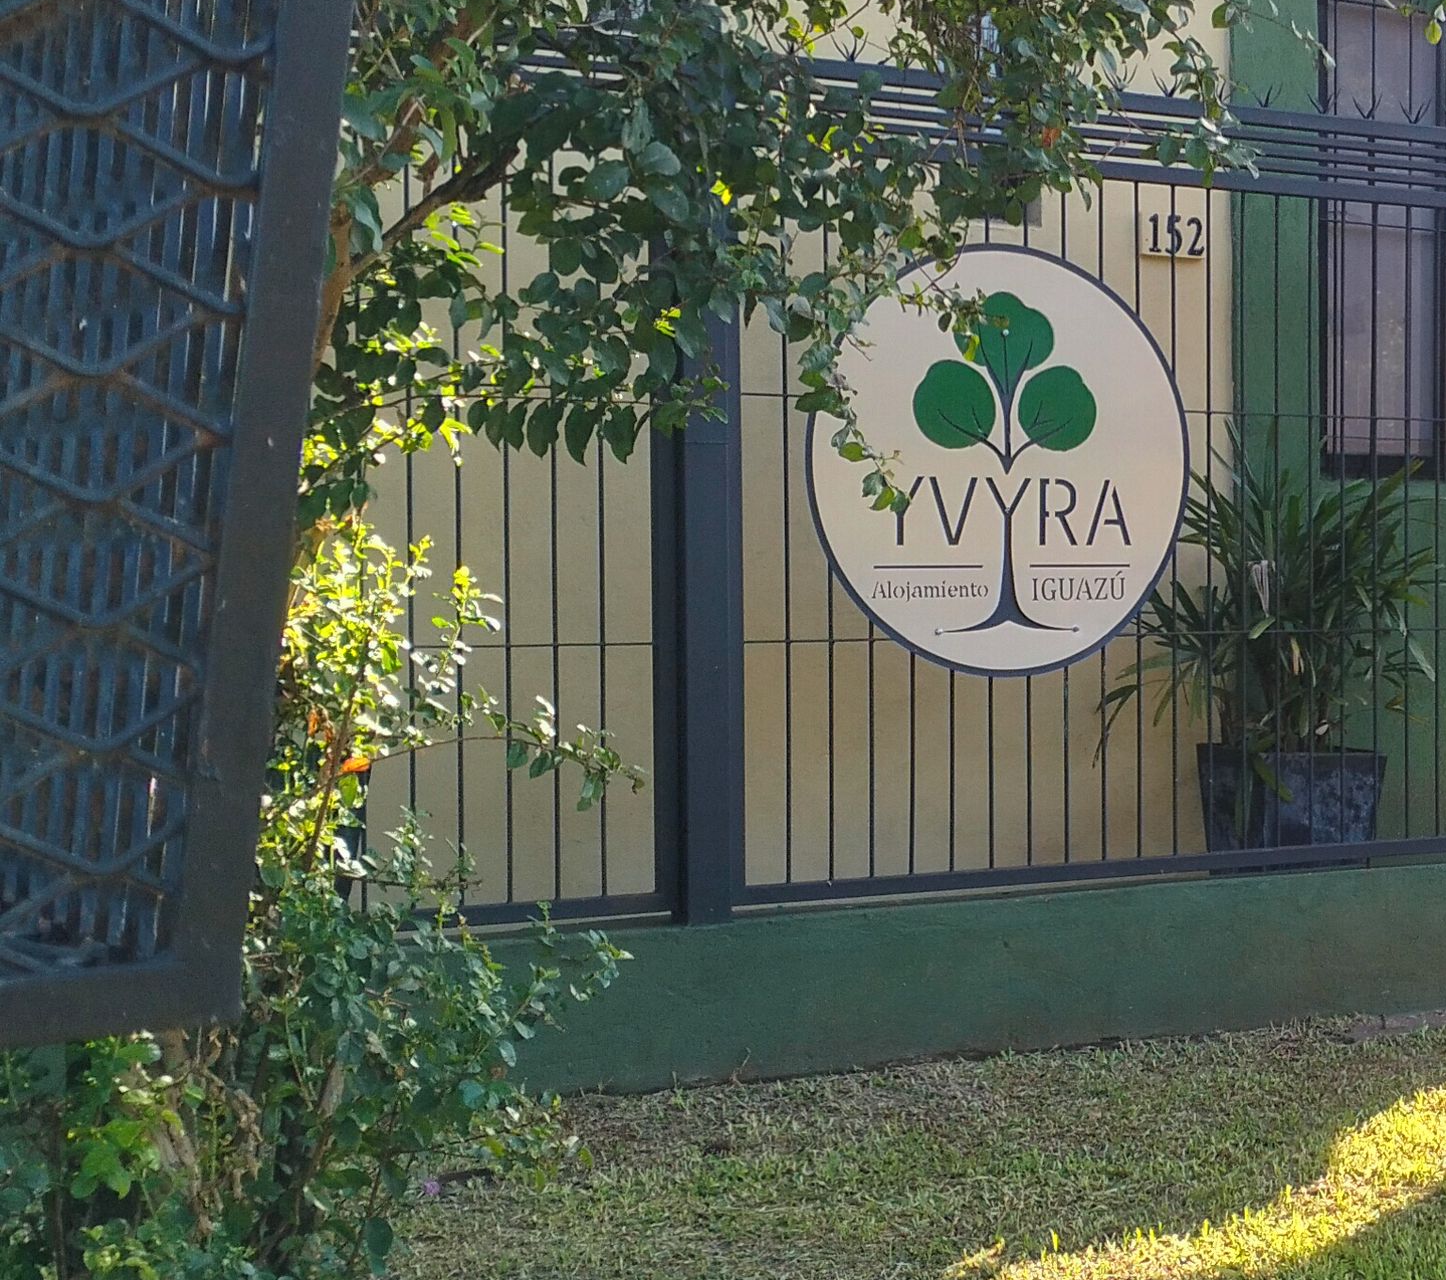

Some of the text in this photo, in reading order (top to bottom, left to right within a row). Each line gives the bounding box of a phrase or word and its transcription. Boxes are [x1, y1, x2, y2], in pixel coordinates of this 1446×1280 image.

[1148, 213, 1205, 256] 152
[891, 475, 1132, 547] YVYRA
[871, 571, 1126, 602] Alojamiento IGUAZÚ
